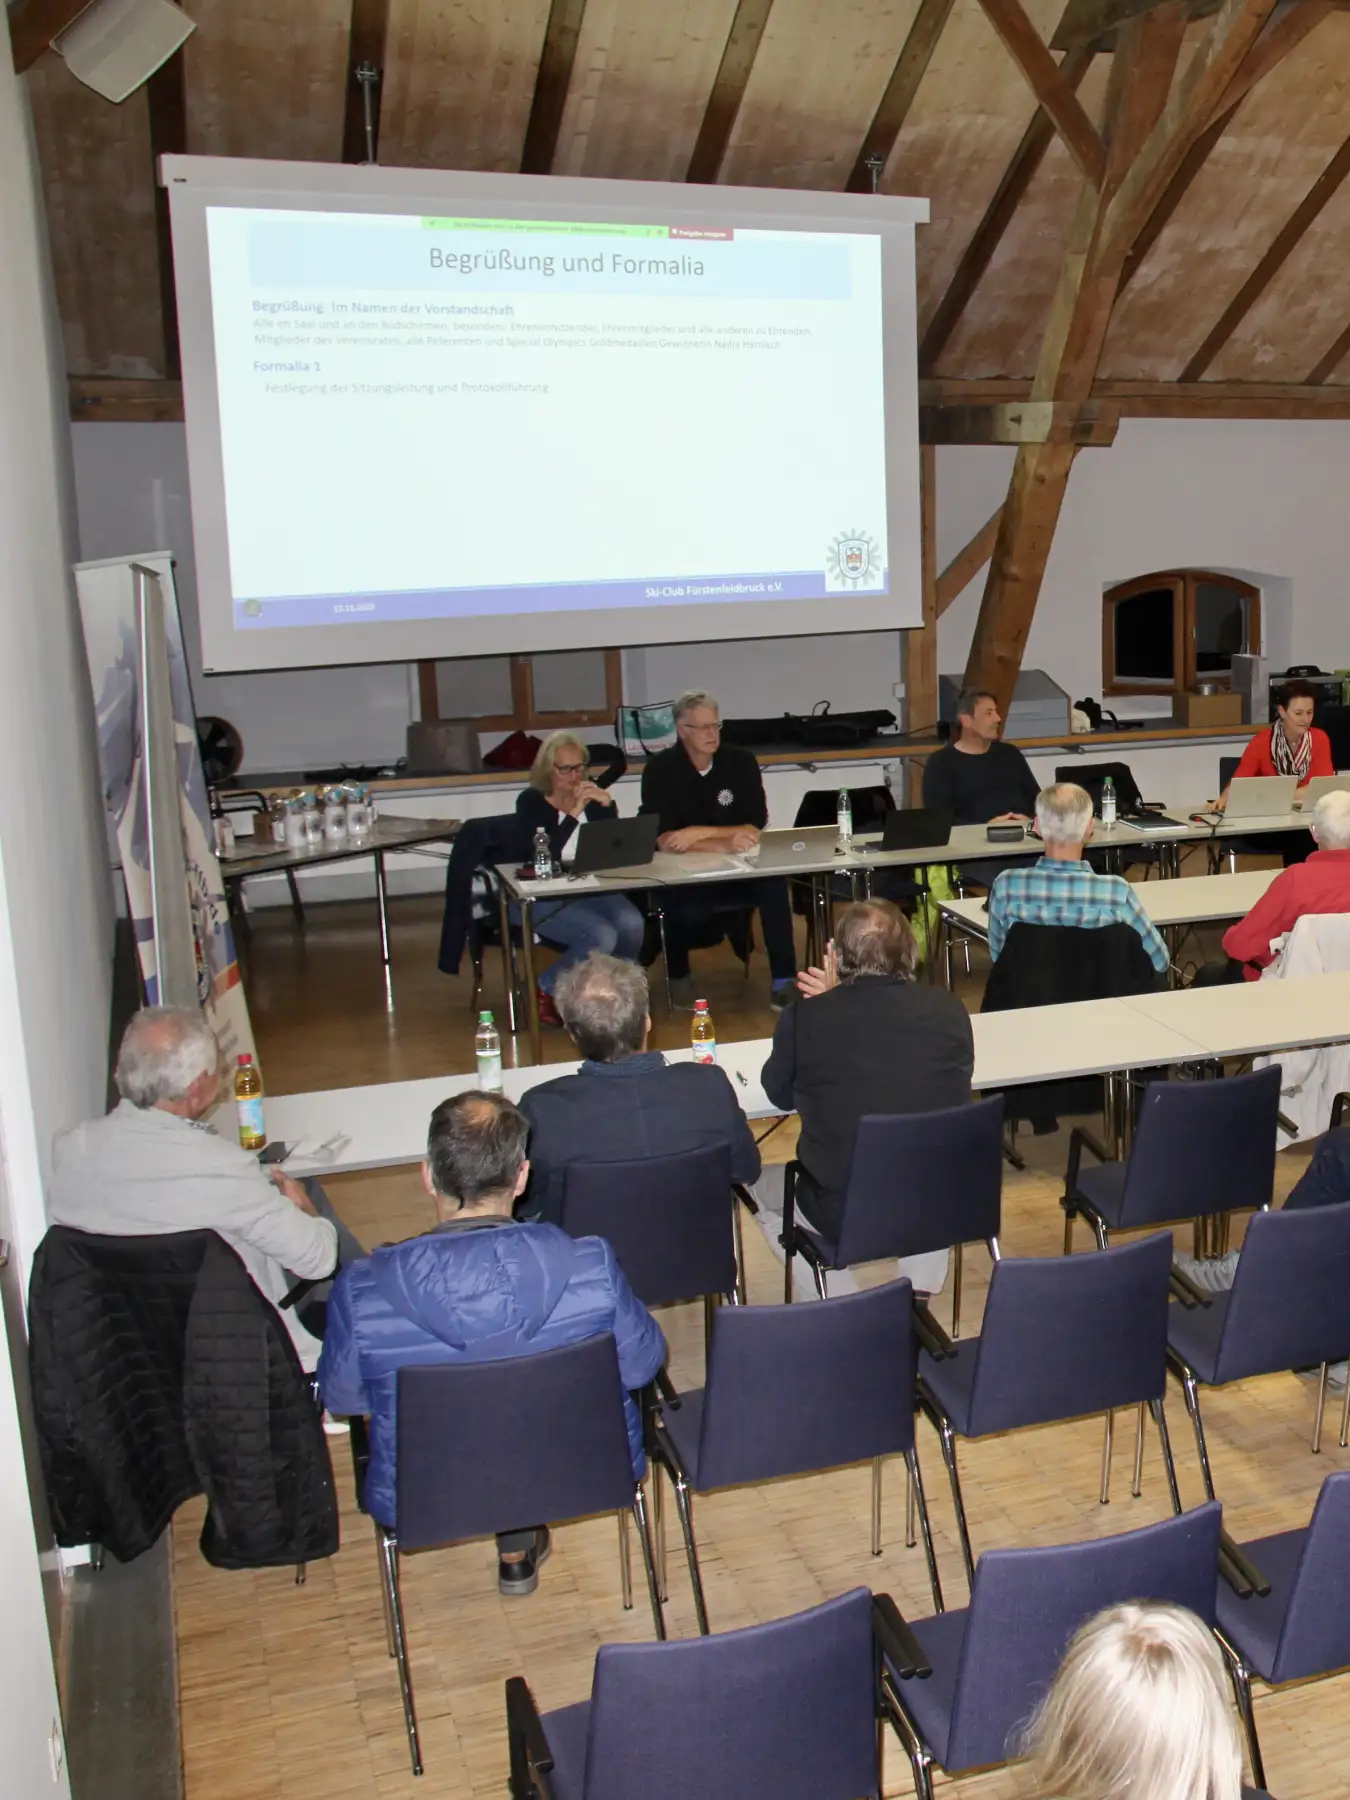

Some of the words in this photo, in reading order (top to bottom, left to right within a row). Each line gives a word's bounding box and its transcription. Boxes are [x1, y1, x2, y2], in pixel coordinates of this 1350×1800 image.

[429, 247, 555, 277] Begrüßung
[562, 252, 605, 273] und
[612, 254, 705, 276] Formalia
[332, 302, 348, 313] Im
[352, 302, 398, 314] Namen
[400, 303, 422, 314] der
[425, 303, 515, 315] Vorstandschaft
[253, 318, 274, 329] Alle
[319, 319, 340, 329] und
[359, 320, 378, 329] den
[678, 324, 696, 333] und
[254, 334, 312, 346] Mitglieder
[314, 335, 332, 345] des
[485, 336, 504, 346] und
[543, 337, 587, 348] Olympics
[253, 360, 310, 372] Formalia
[314, 361, 321, 372] 1
[265, 382, 327, 395] Festlegung
[330, 383, 348, 393] der
[351, 382, 435, 395] Sitzungsleitung
[438, 383, 458, 393] und
[645, 585, 685, 598] Ski-Club
[686, 582, 765, 596] Fürstenfeldbruck
[767, 581, 784, 592] e.V.
